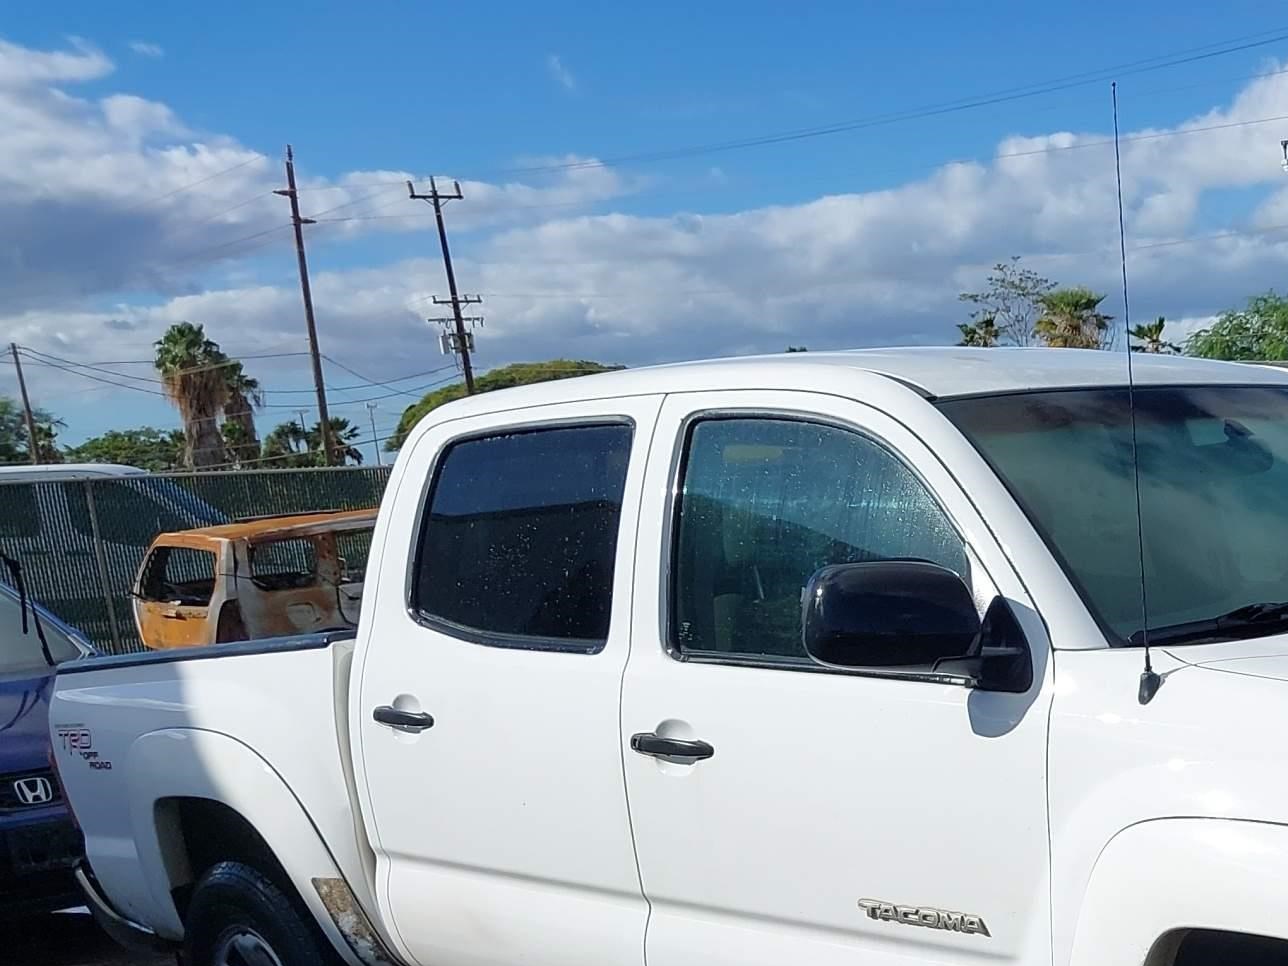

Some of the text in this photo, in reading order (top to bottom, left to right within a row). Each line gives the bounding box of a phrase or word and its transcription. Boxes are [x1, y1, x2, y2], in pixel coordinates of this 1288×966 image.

[58, 728, 92, 757] TRD
[88, 761, 112, 770] ROAD
[857, 898, 992, 937] TACOMA
